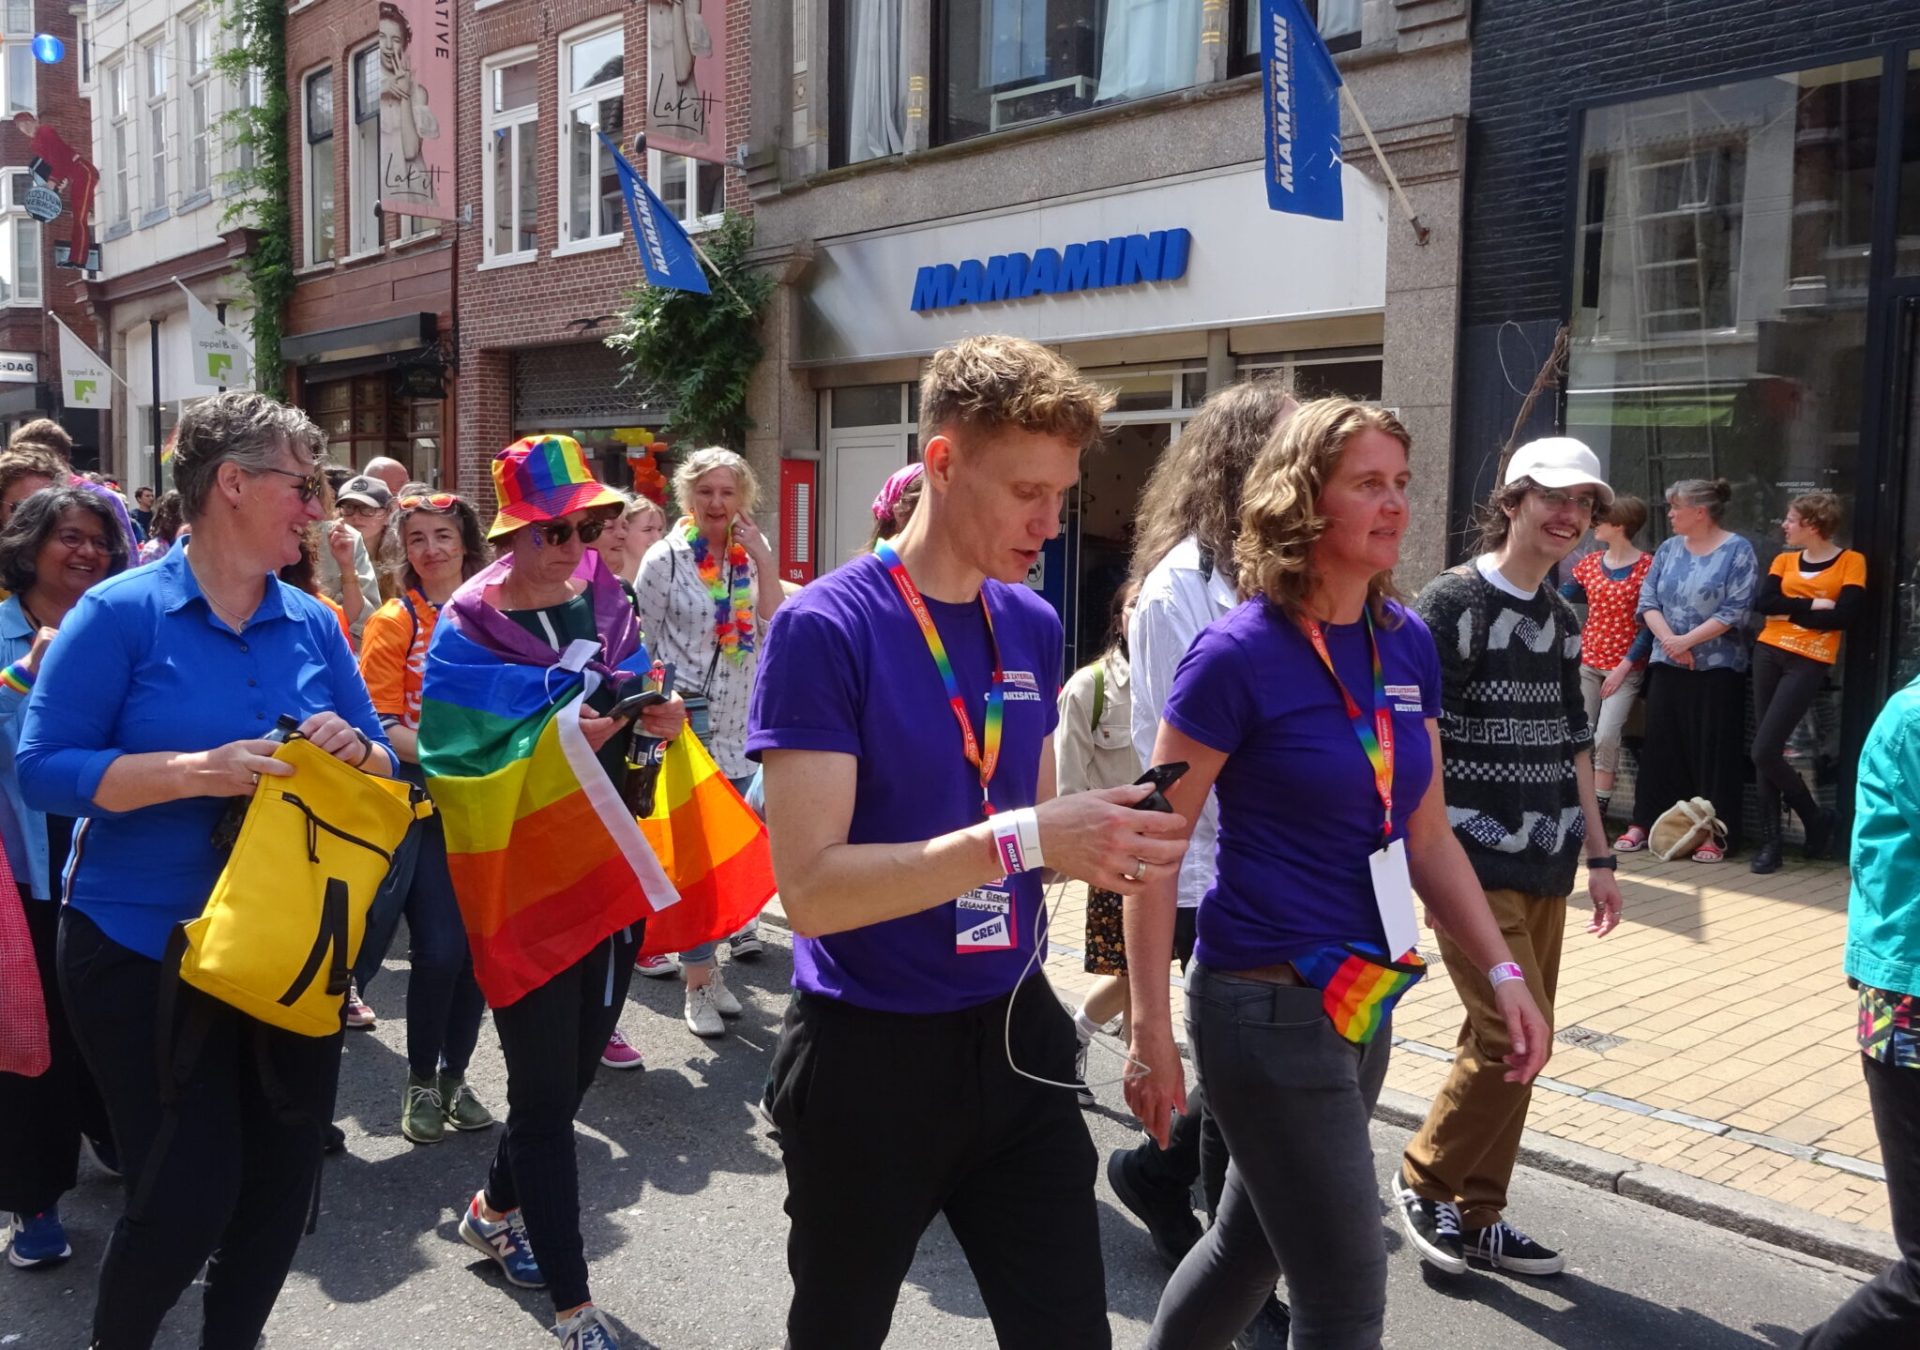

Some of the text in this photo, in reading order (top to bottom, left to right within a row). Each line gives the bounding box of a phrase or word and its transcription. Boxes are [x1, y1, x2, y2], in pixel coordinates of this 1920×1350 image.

[1273, 13, 1294, 193] MAMAMINI
[631, 177, 670, 276] MAMAMIN
[911, 228, 1191, 311] MAMAMINI
[789, 569, 803, 579] 19A
[984, 692, 1041, 701] OANISATIE
[1006, 843, 1019, 864] ROZE
[971, 921, 1002, 942] CREW
